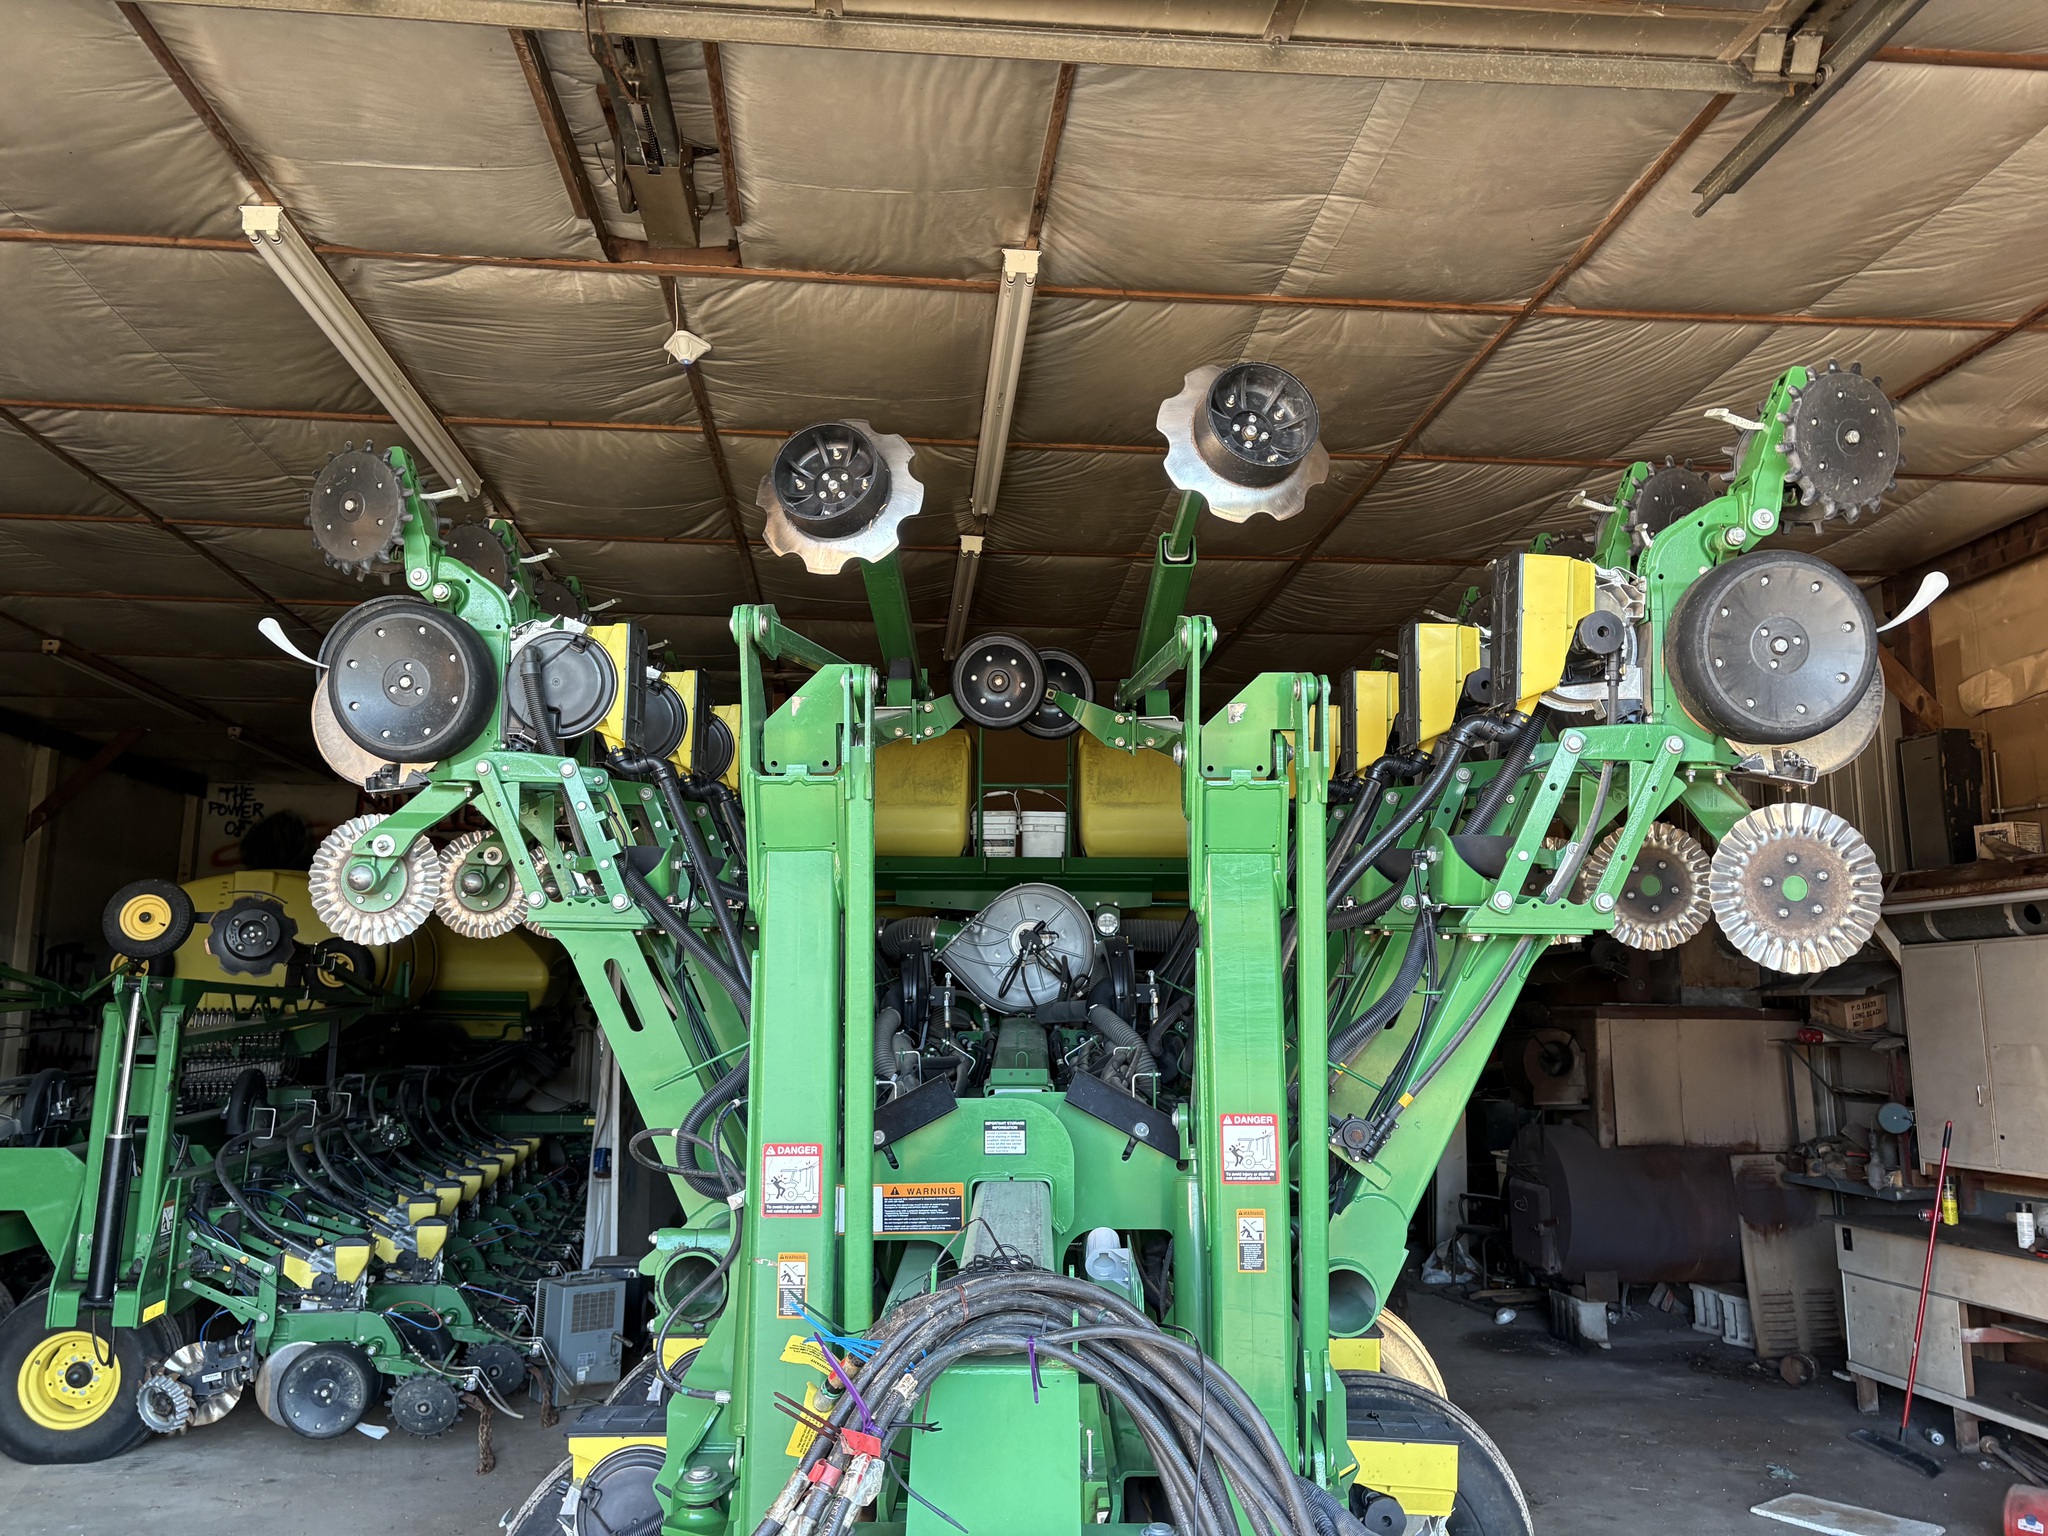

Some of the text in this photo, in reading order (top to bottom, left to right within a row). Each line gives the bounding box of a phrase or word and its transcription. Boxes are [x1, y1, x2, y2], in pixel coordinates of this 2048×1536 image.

[218, 785, 256, 804] THE
[208, 801, 264, 819] POWER
[224, 819, 253, 838] OF
[1234, 1116, 1273, 1124] DANGER
[778, 1146, 818, 1154] DANGER
[906, 1187, 956, 1196] WARNING
[832, 1500, 842, 1514] SAE
